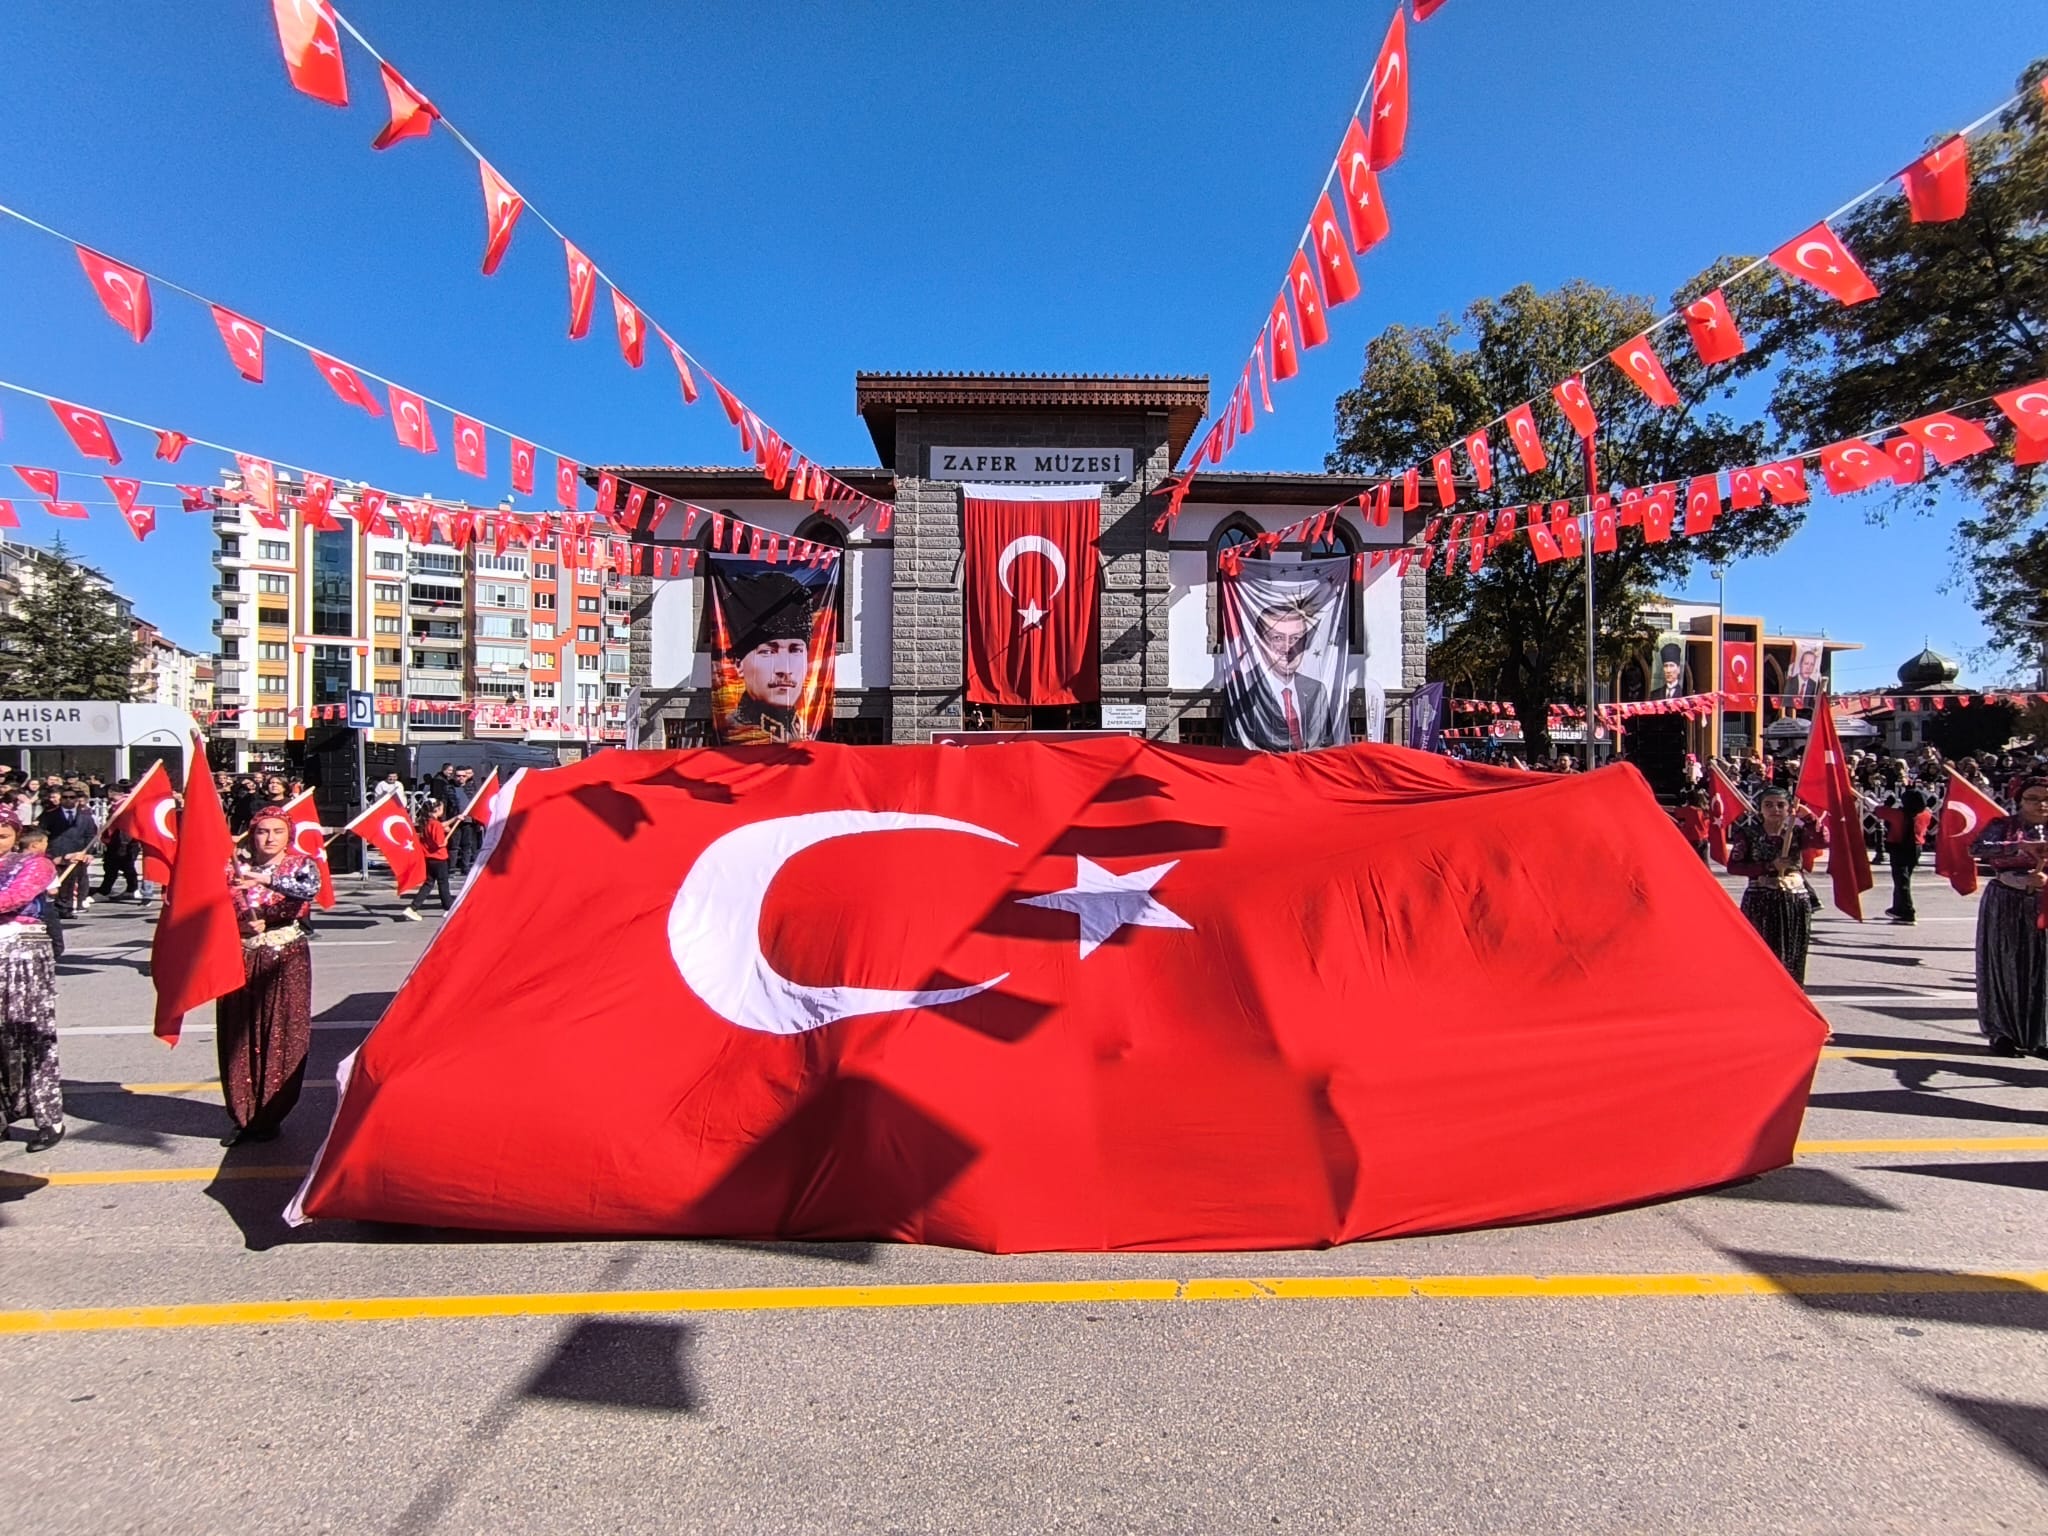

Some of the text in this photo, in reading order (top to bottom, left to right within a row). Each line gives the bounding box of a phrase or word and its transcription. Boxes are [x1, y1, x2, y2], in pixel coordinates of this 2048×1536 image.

[943, 454, 1121, 473] ZAFER MÜZESİ
[2, 704, 81, 722] AHİSAR
[355, 699, 367, 718] D
